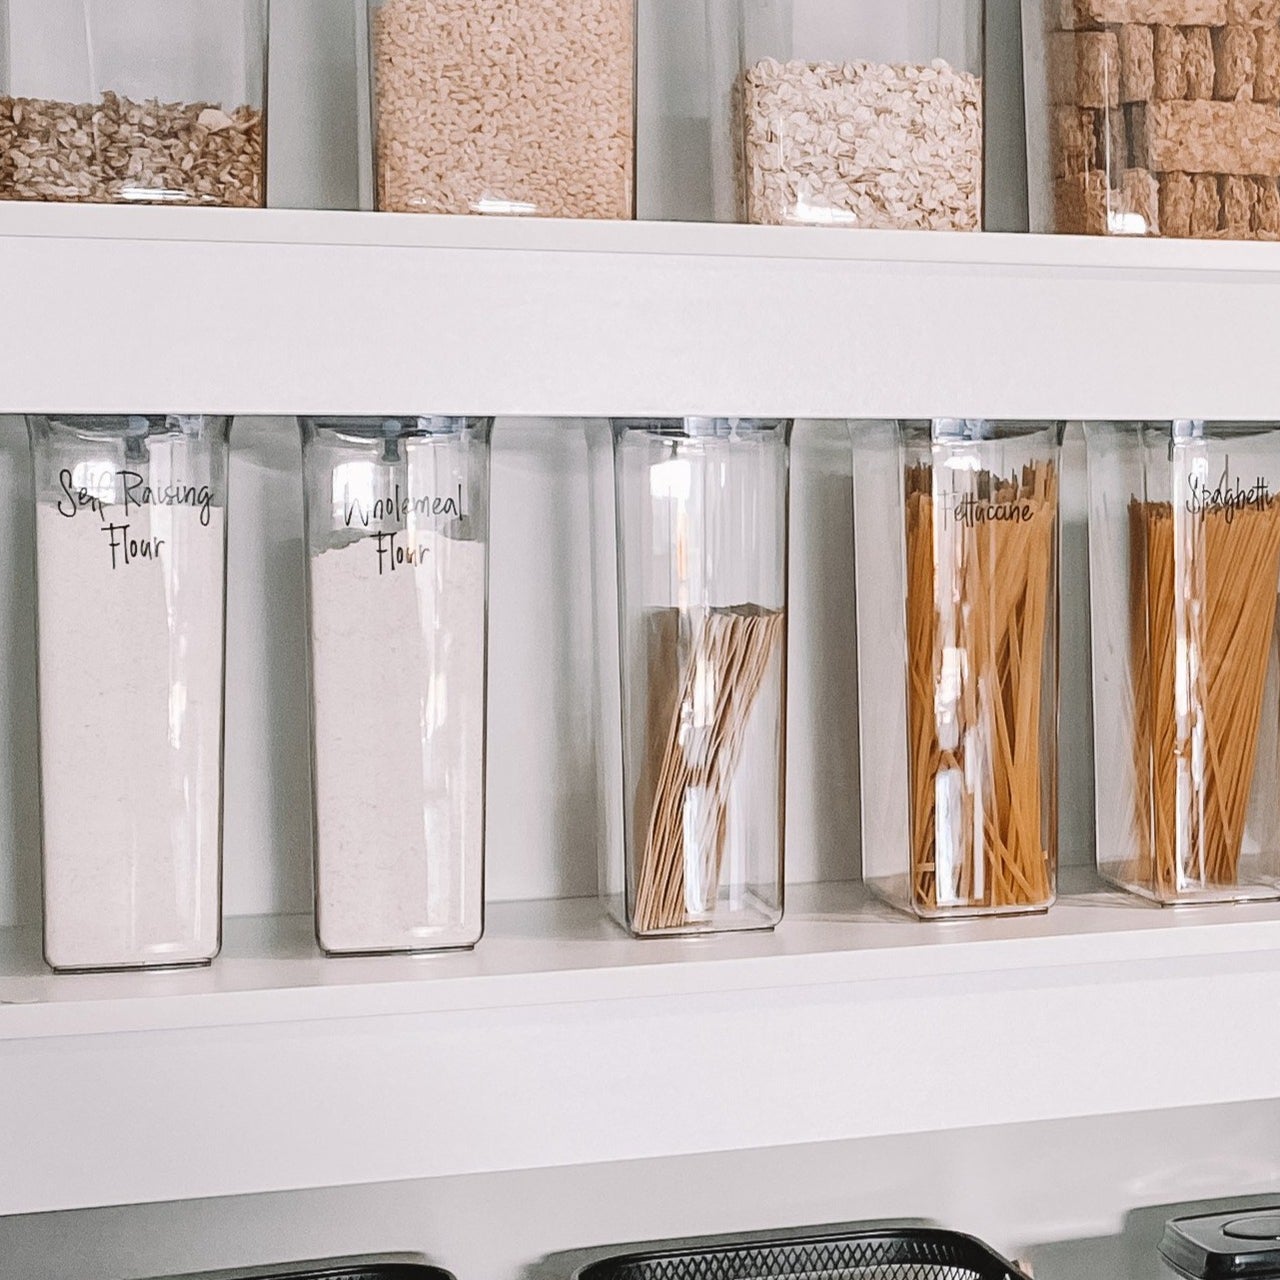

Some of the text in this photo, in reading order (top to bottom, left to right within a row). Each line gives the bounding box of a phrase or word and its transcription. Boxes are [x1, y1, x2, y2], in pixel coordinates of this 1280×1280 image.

[116, 470, 214, 527] Raising
[344, 484, 464, 527] Wholemeal
[1186, 468, 1274, 524] Spaghetti
[101, 523, 165, 569] Flour
[370, 530, 430, 574] Flour
